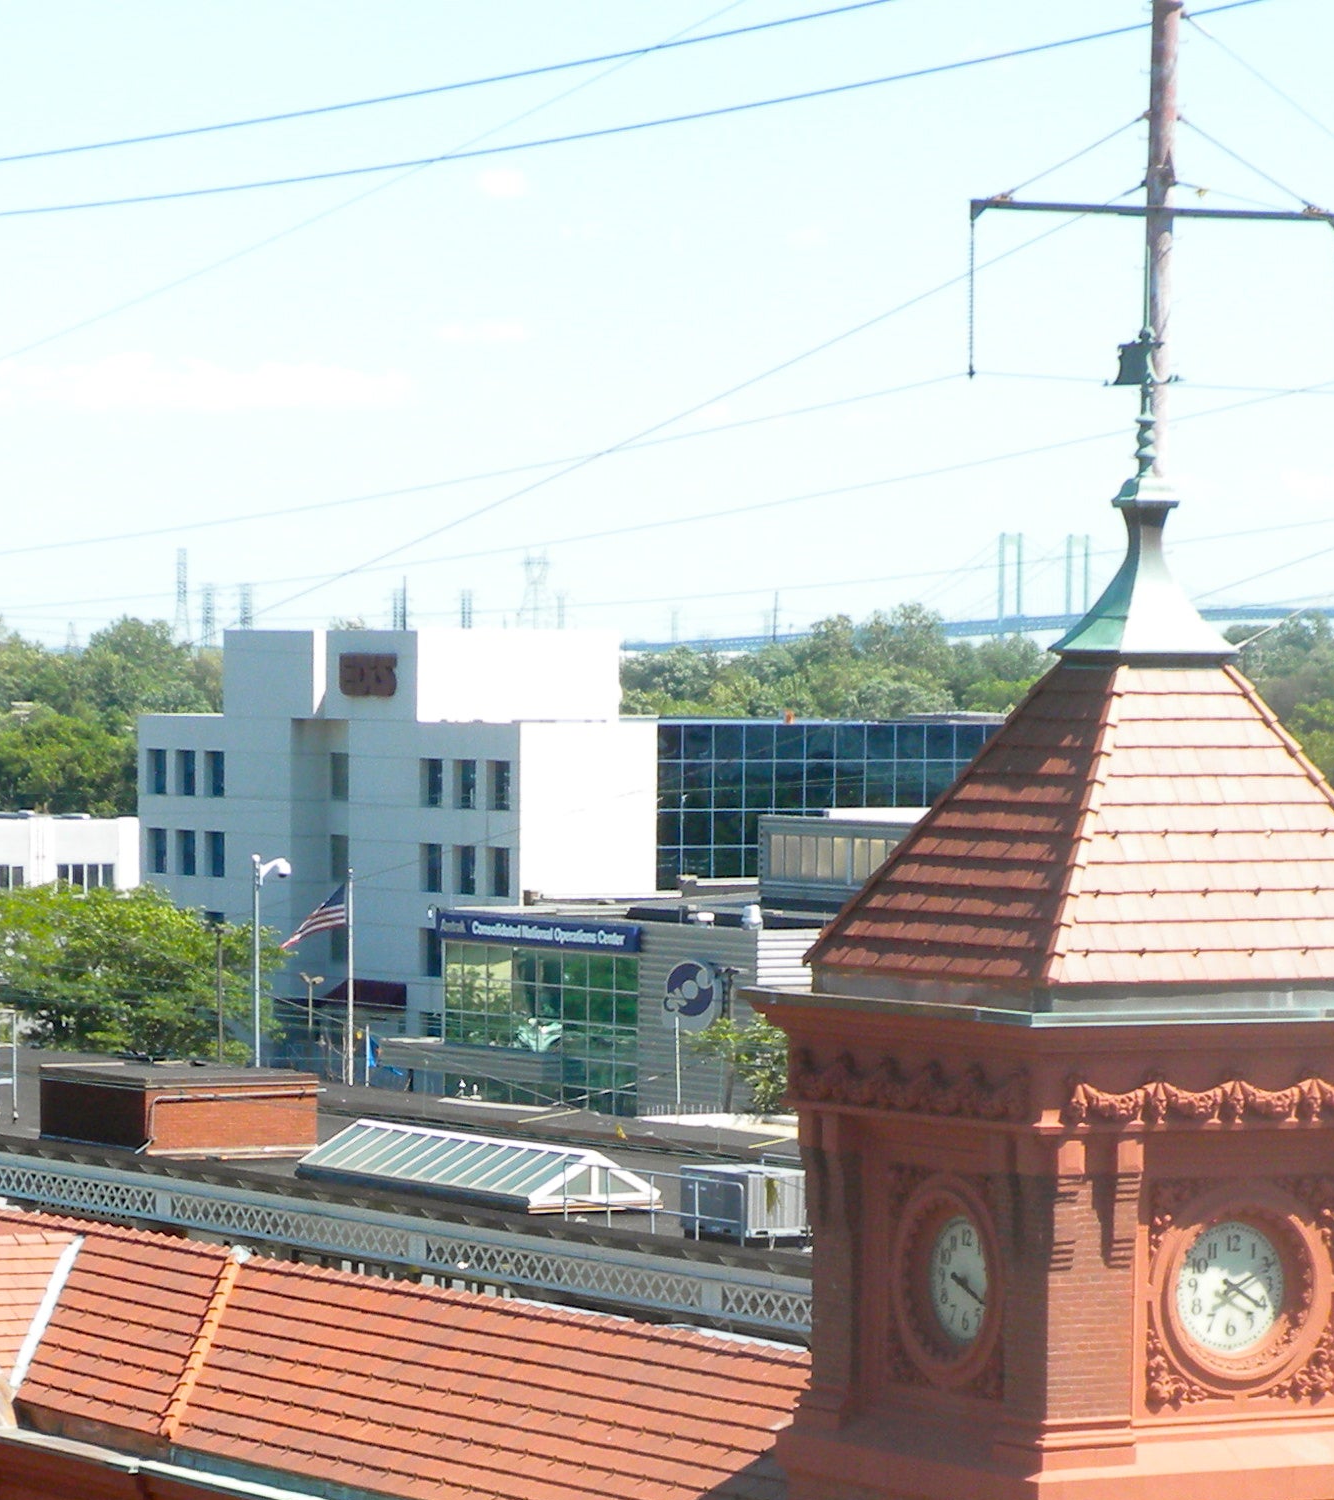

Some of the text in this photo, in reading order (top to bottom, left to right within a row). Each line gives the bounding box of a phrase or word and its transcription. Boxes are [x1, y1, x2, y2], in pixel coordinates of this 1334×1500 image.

[522, 925, 553, 940] National
[554, 927, 597, 945] Operations
[598, 930, 625, 946] Center
[962, 1229, 972, 1247] 12
[1227, 1234, 1241, 1252] 12
[1208, 1242, 1217, 1259] 11
[1251, 1243, 1256, 1259] 1
[1192, 1258, 1208, 1274] 10
[1188, 1278, 1198, 1296] 9
[1192, 1299, 1202, 1316] 8
[962, 1311, 969, 1331] 6
[1207, 1313, 1216, 1333] 7
[1226, 1320, 1236, 1337] 6
